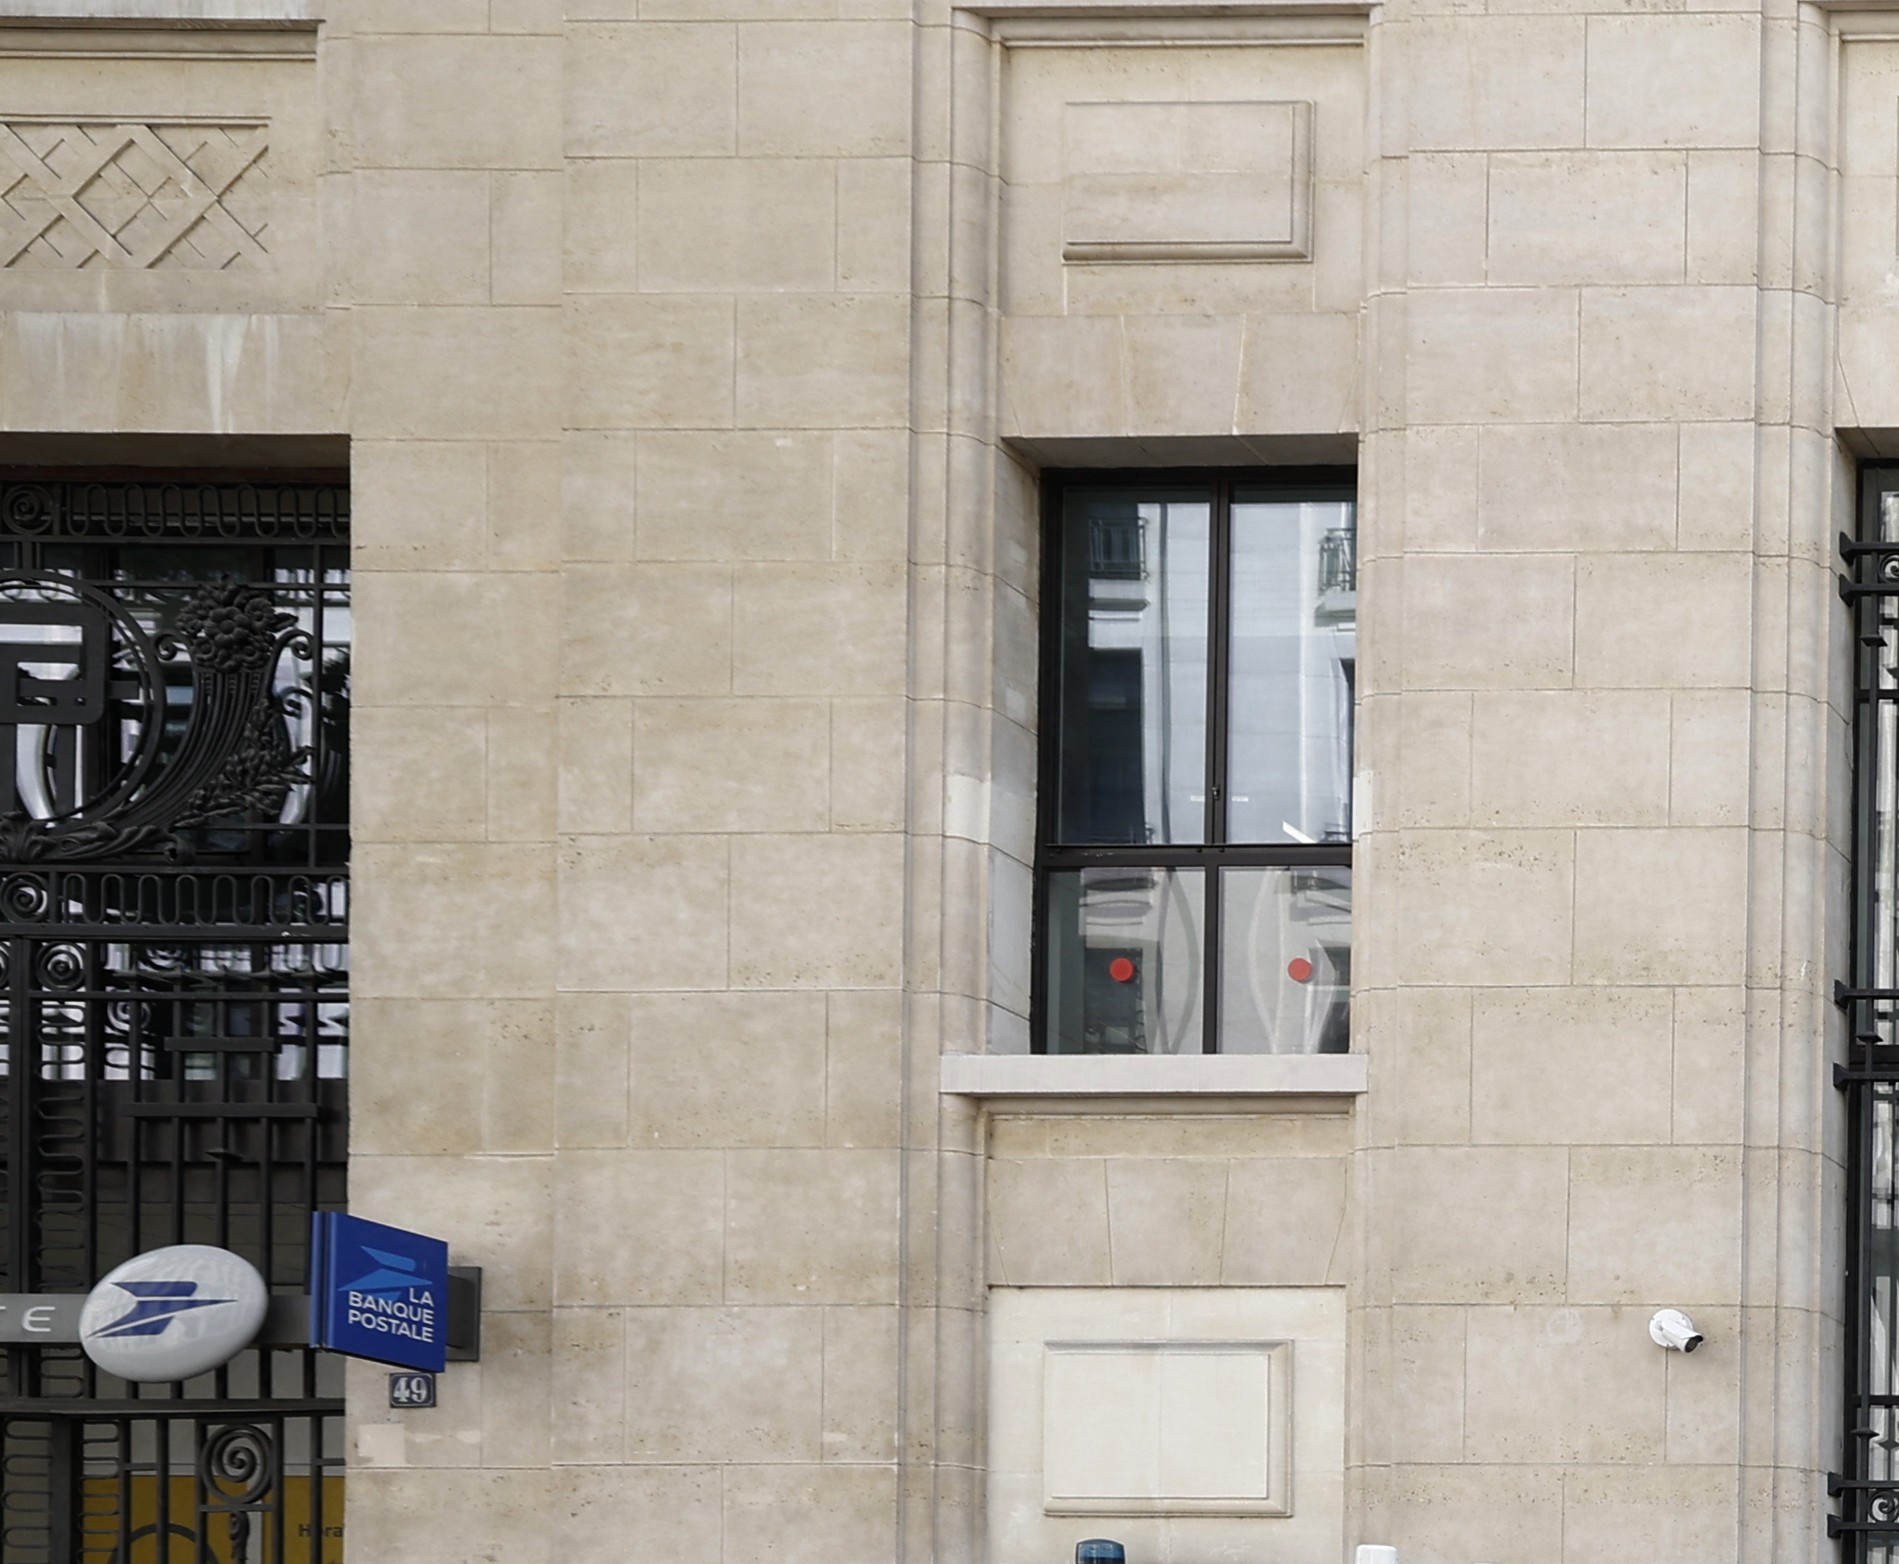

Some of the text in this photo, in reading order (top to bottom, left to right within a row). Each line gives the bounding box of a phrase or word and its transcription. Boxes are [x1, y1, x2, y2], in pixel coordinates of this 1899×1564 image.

[348, 1290, 435, 1326] BANQUE
[408, 1286, 435, 1308] LA
[347, 1308, 434, 1344] POSTALE
[392, 1376, 428, 1403] 49
